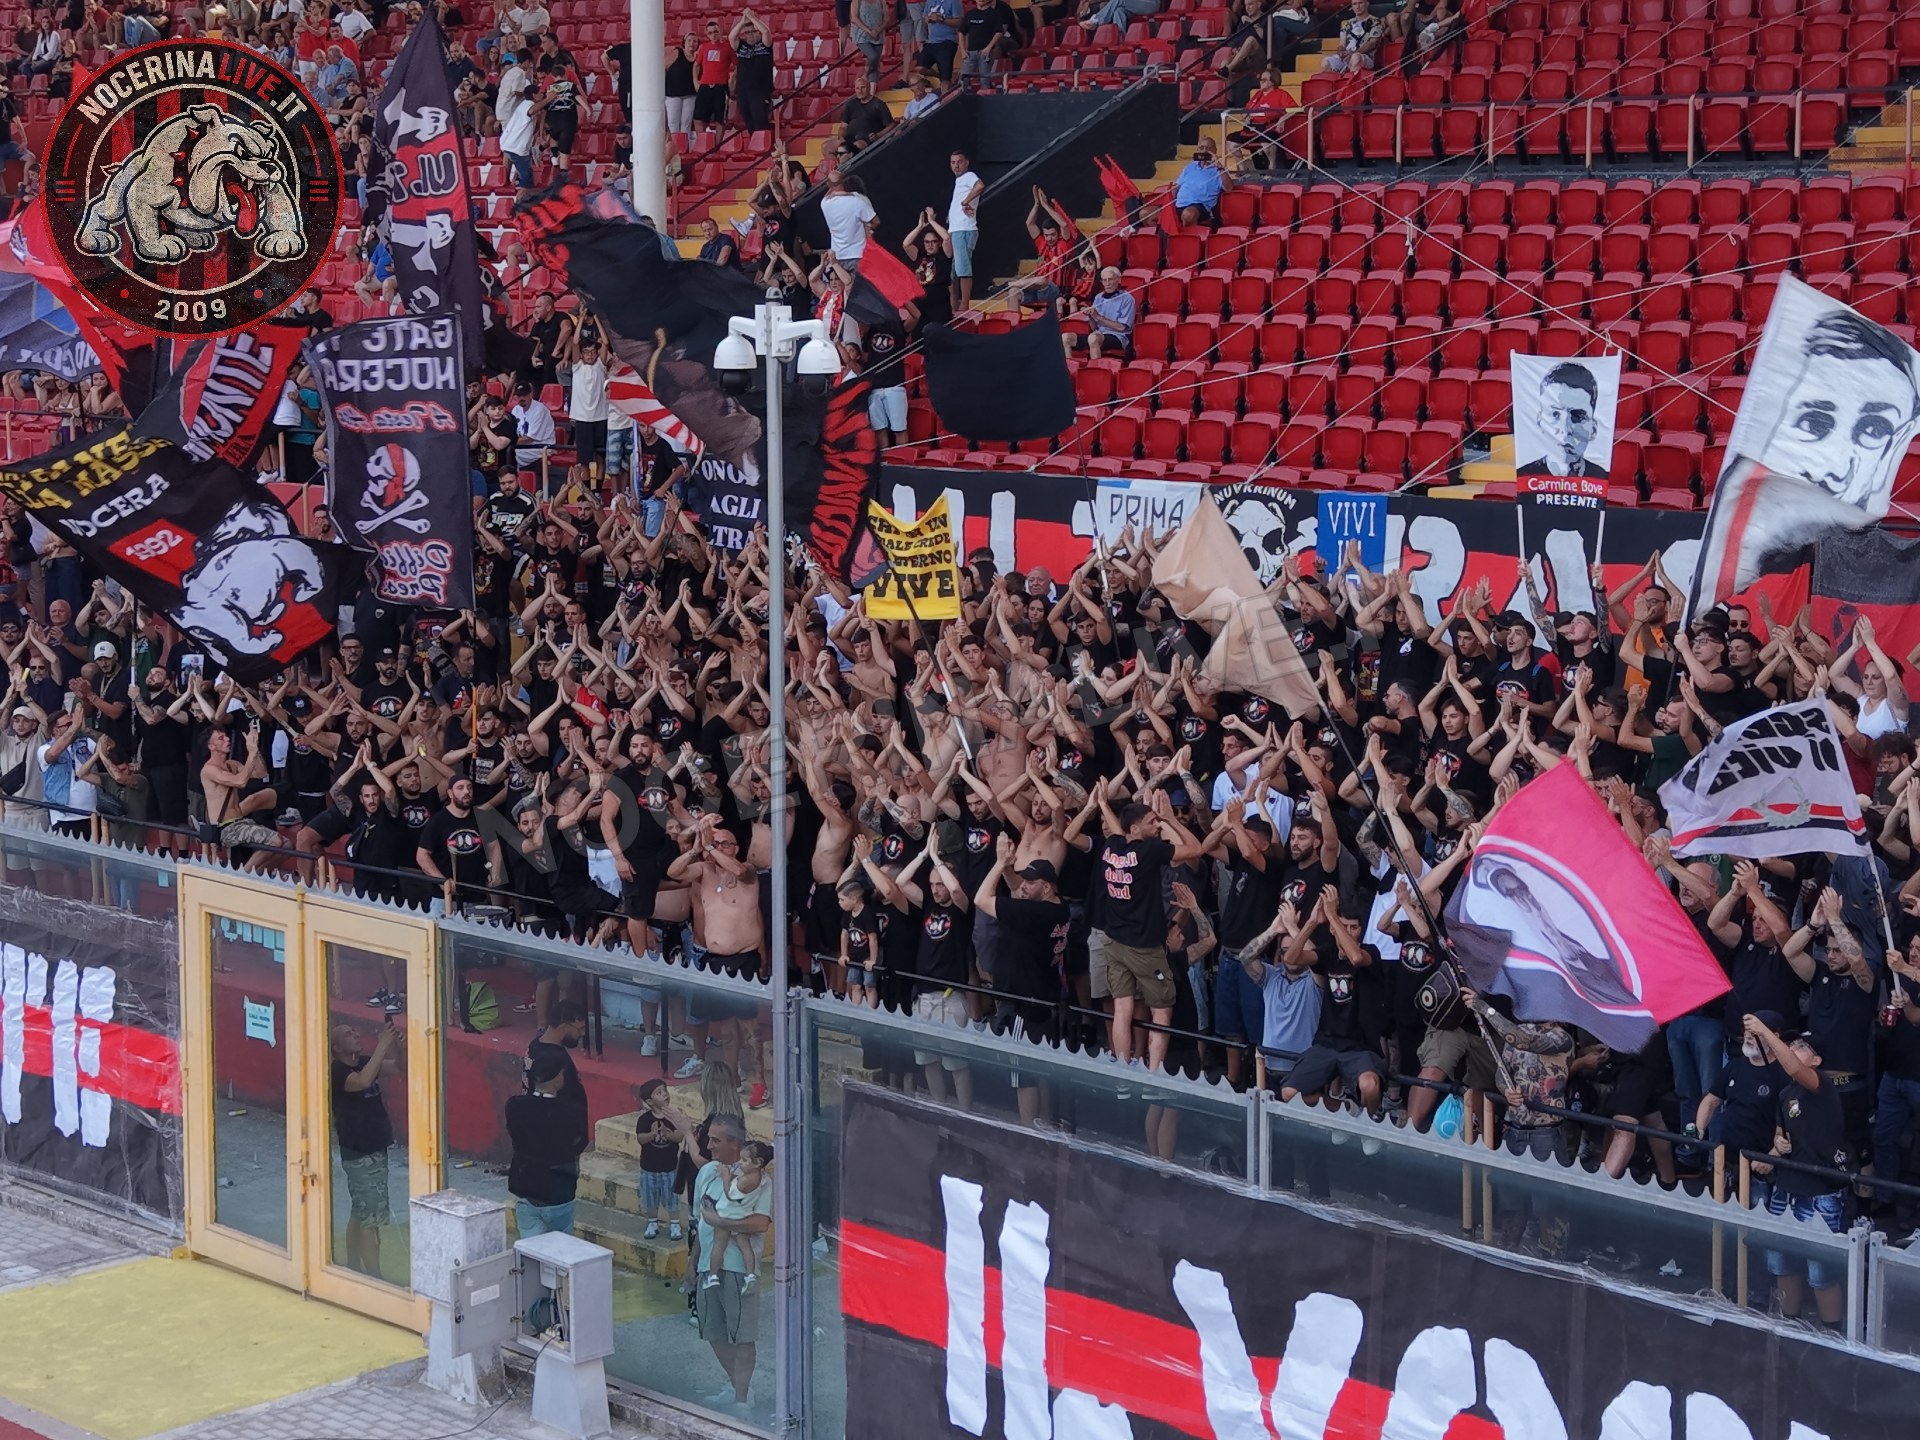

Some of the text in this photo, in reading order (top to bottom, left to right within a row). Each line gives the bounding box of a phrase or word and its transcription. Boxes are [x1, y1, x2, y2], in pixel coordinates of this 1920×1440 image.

[1527, 477, 1578, 492] Carmine
[709, 494, 761, 520] AGLI
[1109, 494, 1183, 529] PRIMA
[1536, 494, 1598, 508] PRESENTE
[1327, 502, 1376, 537] VIVI
[873, 569, 957, 600] VIVE
